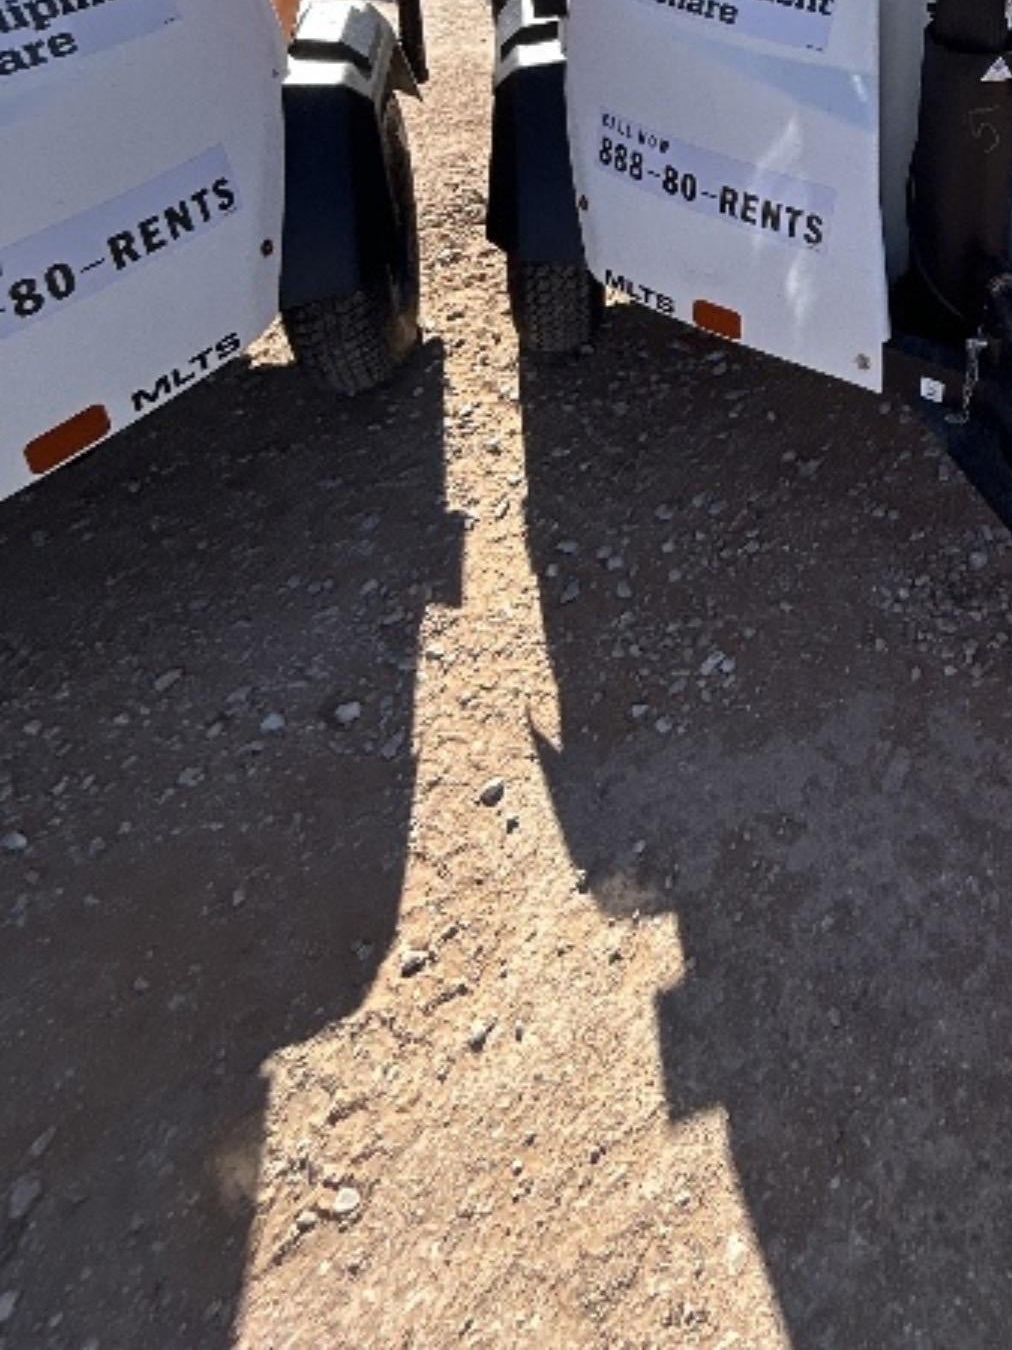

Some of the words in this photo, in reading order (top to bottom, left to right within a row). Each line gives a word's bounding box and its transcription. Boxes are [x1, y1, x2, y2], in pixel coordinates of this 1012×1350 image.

[599, 137, 823, 245] 888-80-RENTS
[605, 269, 675, 312] MLTS
[131, 332, 241, 412] MLTS
